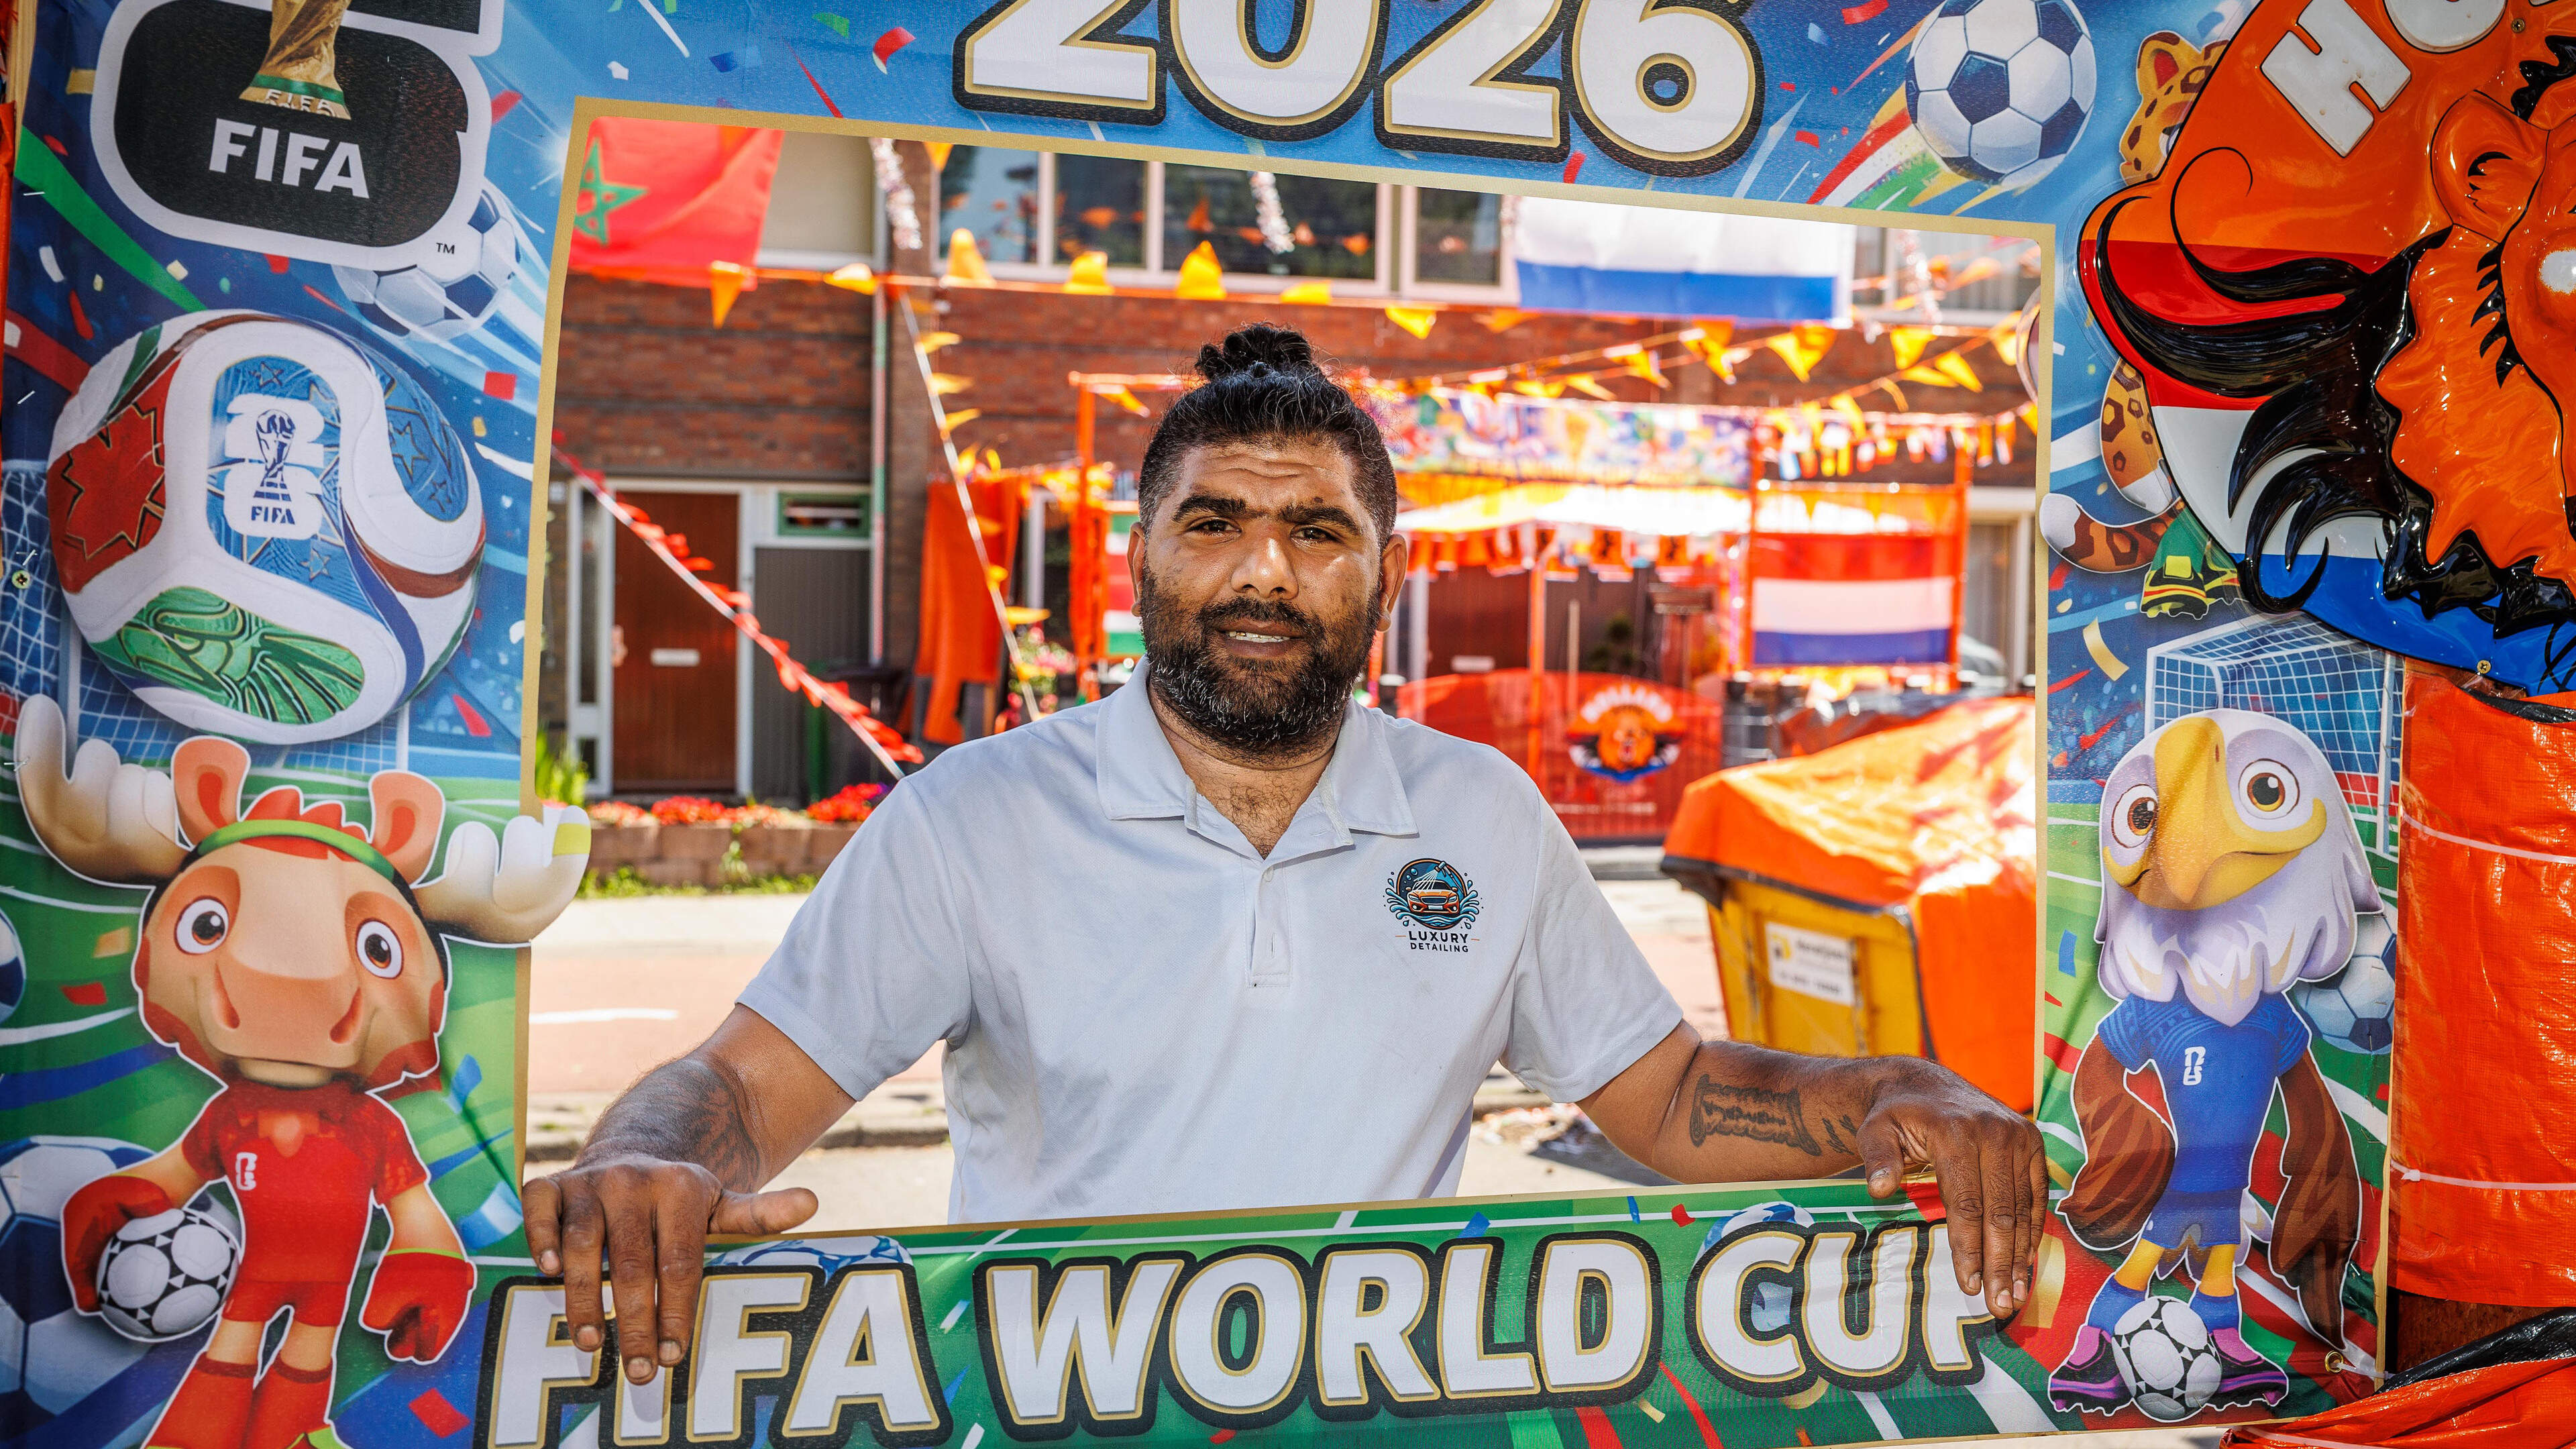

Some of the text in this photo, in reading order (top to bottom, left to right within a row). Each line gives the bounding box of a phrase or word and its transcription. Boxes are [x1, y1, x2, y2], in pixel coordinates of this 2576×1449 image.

[209, 118, 369, 199] FIFA
[436, 242, 455, 254] TM
[251, 506, 295, 525] FIFA
[1409, 930, 1468, 944] LUXURY
[1410, 943, 1468, 953] DETAILING
[984, 1238, 1654, 1427] WORLD
[1694, 1222, 2002, 1385] CUP
